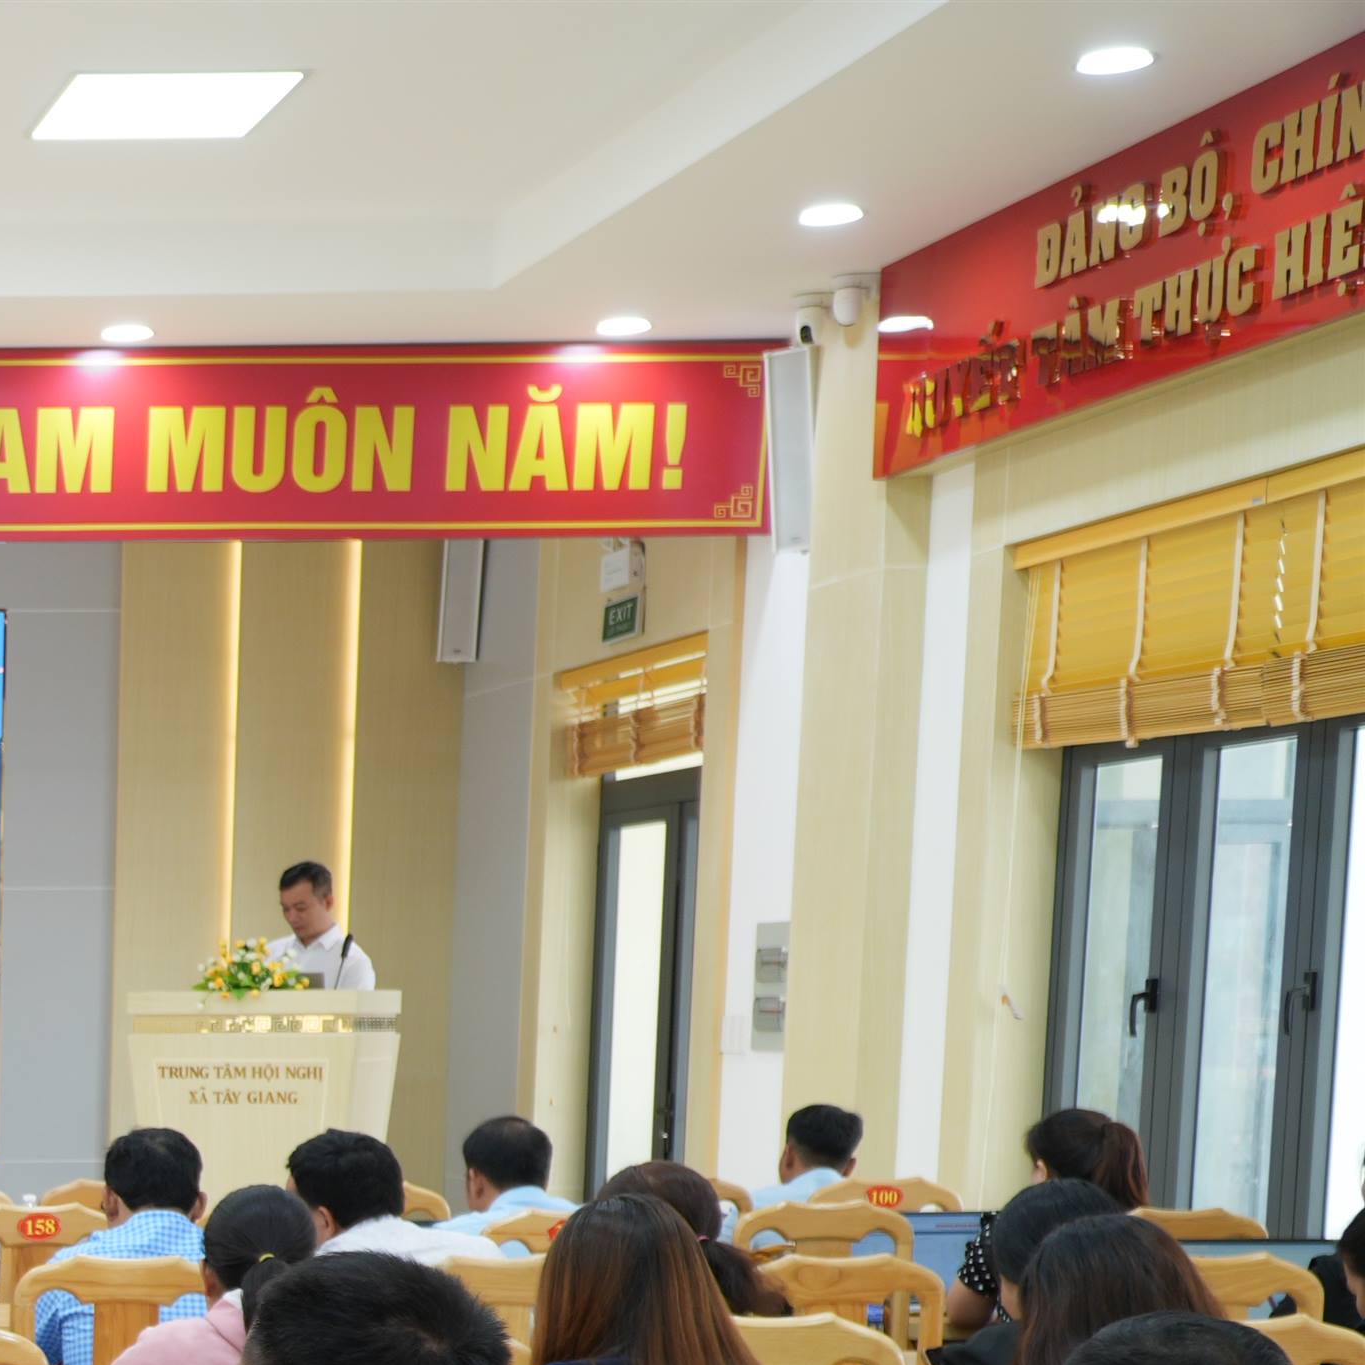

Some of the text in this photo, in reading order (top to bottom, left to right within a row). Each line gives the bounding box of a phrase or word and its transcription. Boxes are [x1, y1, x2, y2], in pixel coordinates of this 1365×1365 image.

[1031, 296, 1131, 388] TÂM
[1133, 235, 1257, 348] THỰC
[1272, 182, 1365, 299] HIỆ
[146, 386, 416, 493] MUÔN
[445, 383, 688, 492] NĂM!
[609, 603, 633, 626] EXIT
[158, 1062, 323, 1082] TRUNG TÂM HỘI NGHỊ
[189, 1086, 299, 1104] XÃ TÂY GIANG
[872, 1190, 898, 1205] 100
[26, 1219, 56, 1236] 158
